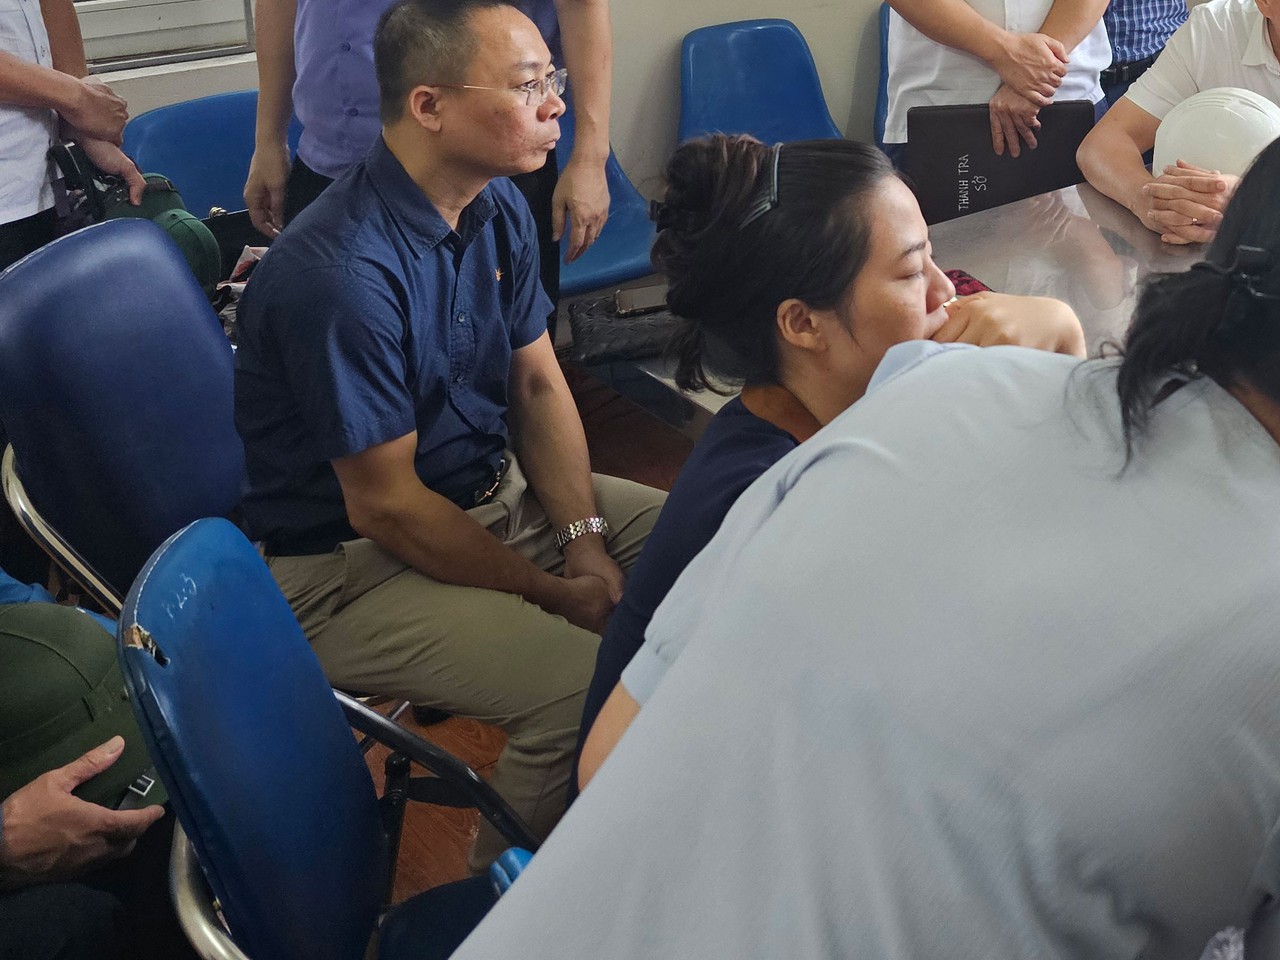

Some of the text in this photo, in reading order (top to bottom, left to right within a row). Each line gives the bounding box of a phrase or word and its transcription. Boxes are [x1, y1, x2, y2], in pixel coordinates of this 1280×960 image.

[958, 154, 969, 211] THANH TRA
[972, 175, 987, 191] SỞ
